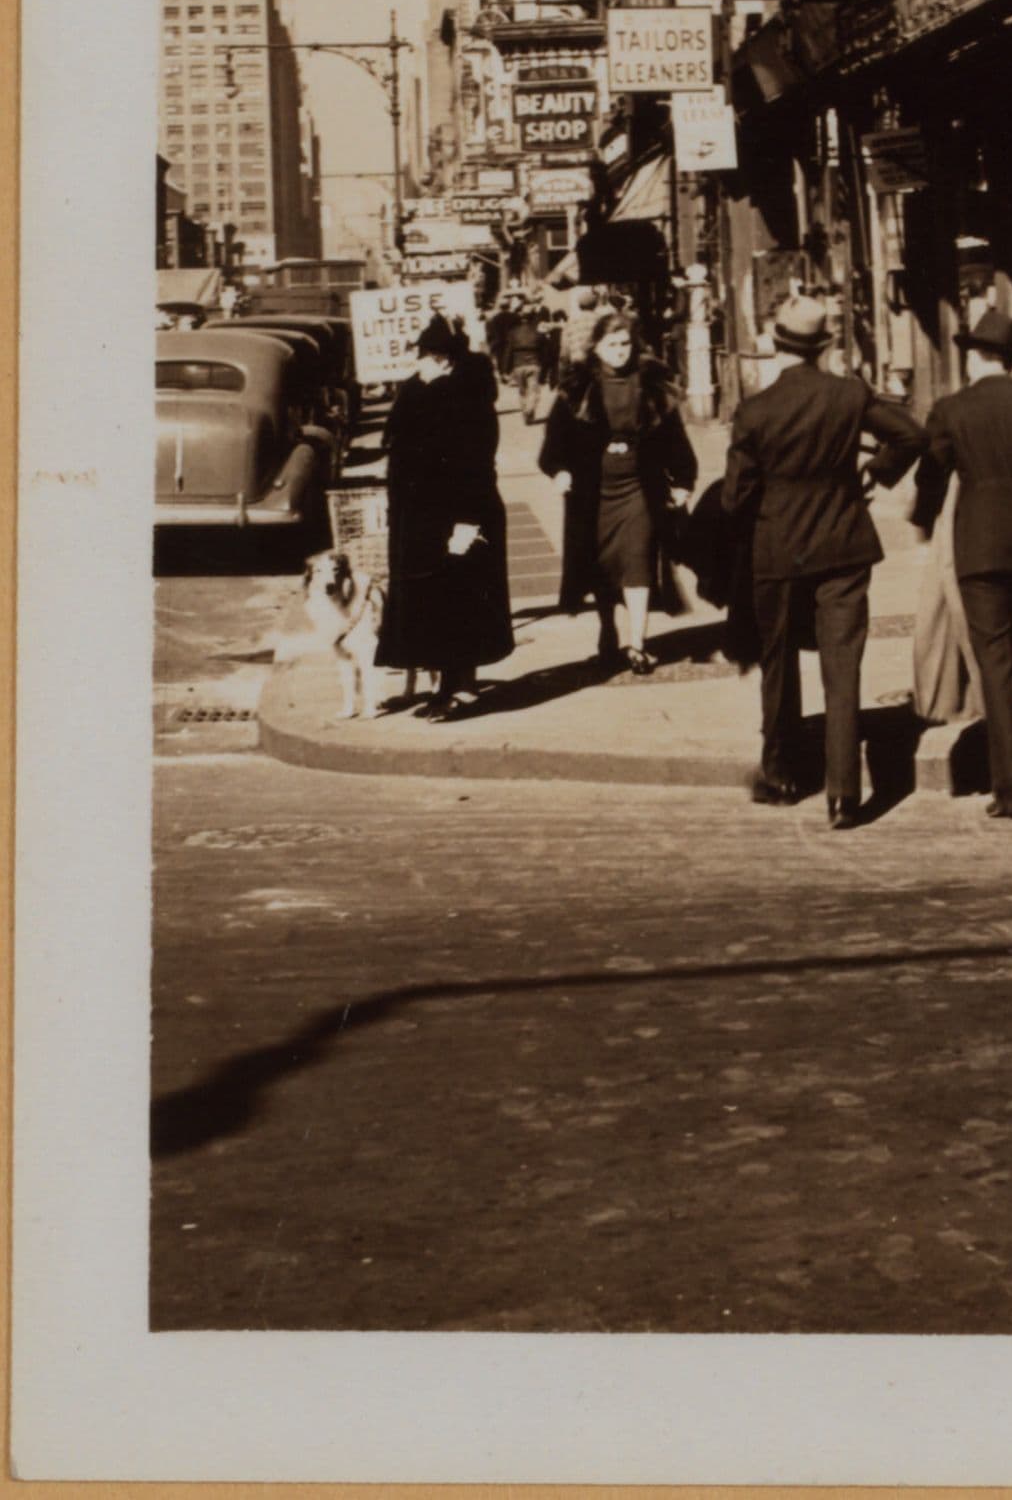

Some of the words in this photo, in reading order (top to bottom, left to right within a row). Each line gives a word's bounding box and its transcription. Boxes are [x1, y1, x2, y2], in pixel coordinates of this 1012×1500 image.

[615, 29, 707, 52] TAILORS
[614, 60, 708, 84] CLEANERS
[515, 92, 596, 115] BEAUTY
[525, 119, 588, 143] SHOP
[378, 292, 447, 315] USE
[362, 316, 422, 338] LITTER
